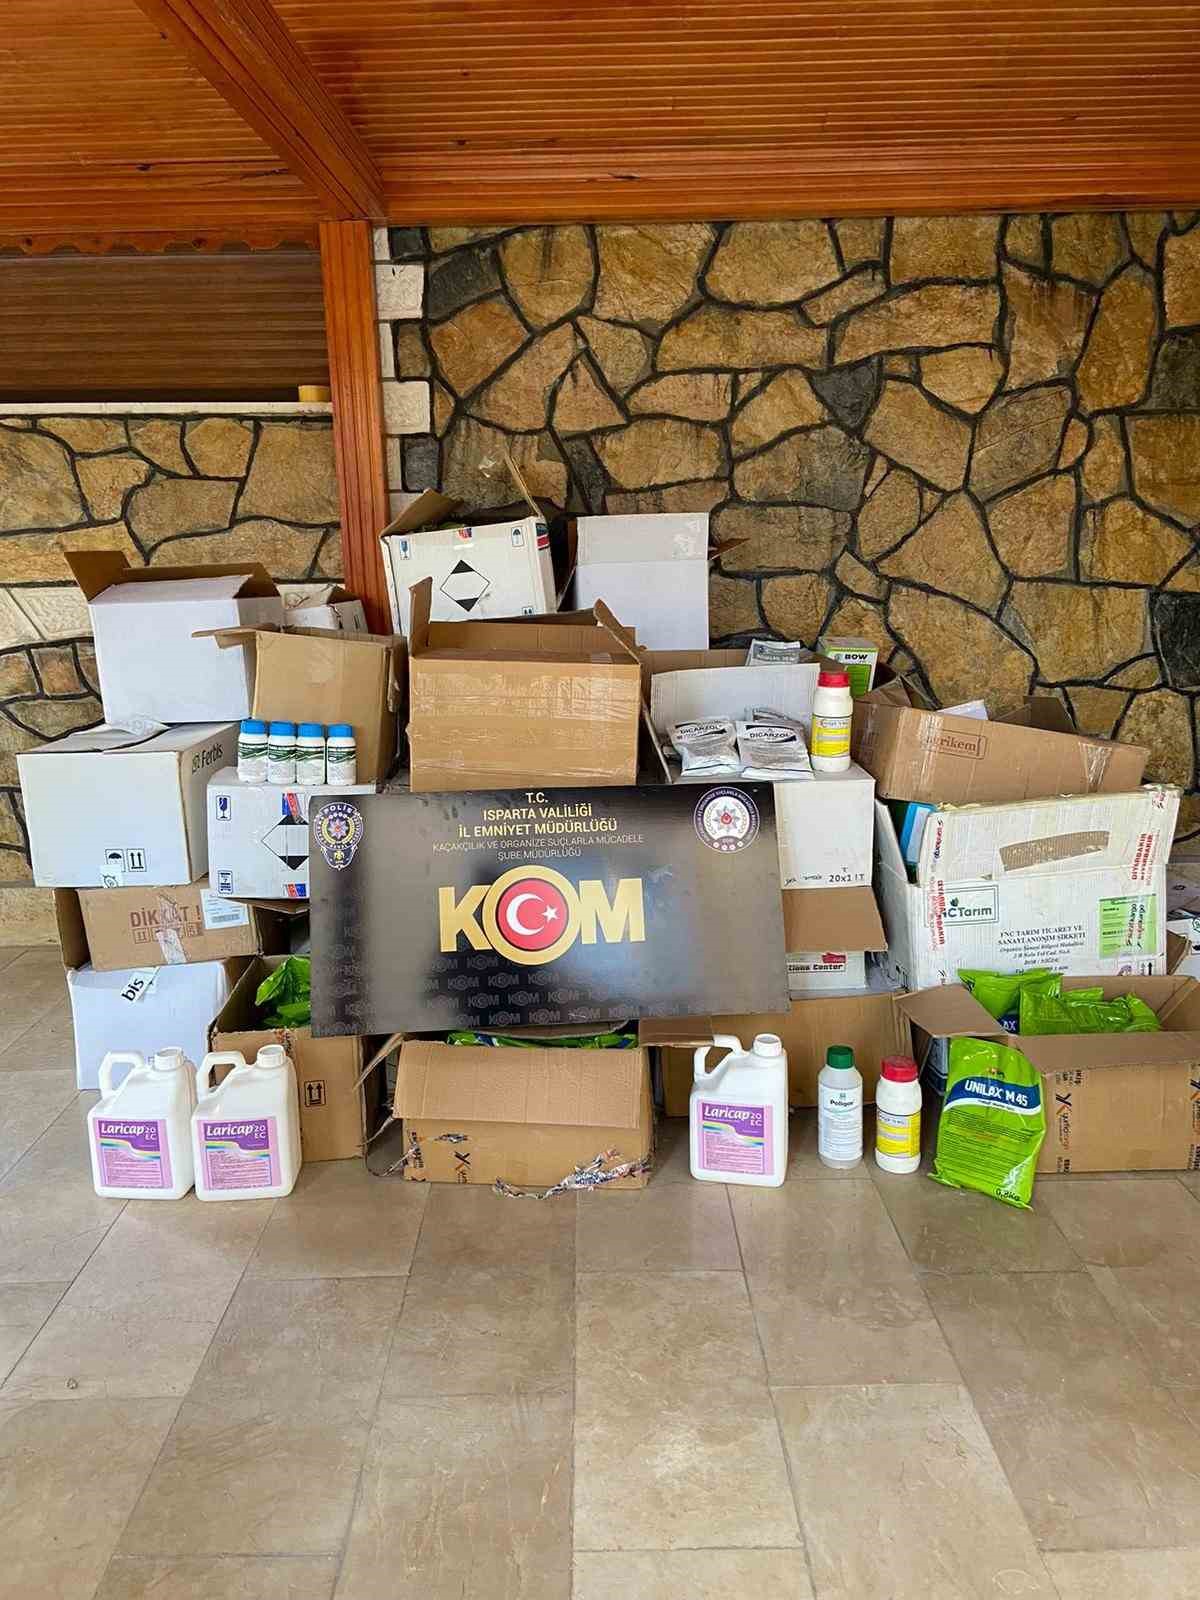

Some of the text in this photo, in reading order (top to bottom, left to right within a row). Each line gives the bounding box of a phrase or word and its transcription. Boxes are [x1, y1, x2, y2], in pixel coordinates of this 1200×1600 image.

[525, 792, 549, 804] T.C.
[483, 803, 593, 821] ISPARTA VALİLİĞİ
[458, 817, 618, 838] İL EMNİYET MÜDÜRLÜĞÜ
[486, 839, 498, 849] VE
[548, 836, 594, 848] SUÇLARLA
[596, 833, 644, 845] MÜCADELE
[497, 847, 582, 861] ŞUBE MÜDÜRLÜĞÜ
[130, 906, 189, 927] DİKT
[439, 864, 647, 966] KOM
[121, 978, 144, 1002] bis
[965, 1080, 1004, 1099] UNILAX
[704, 1105, 749, 1121] Laricap
[101, 1122, 144, 1137] Laricap
[206, 1123, 253, 1137] Laricap
